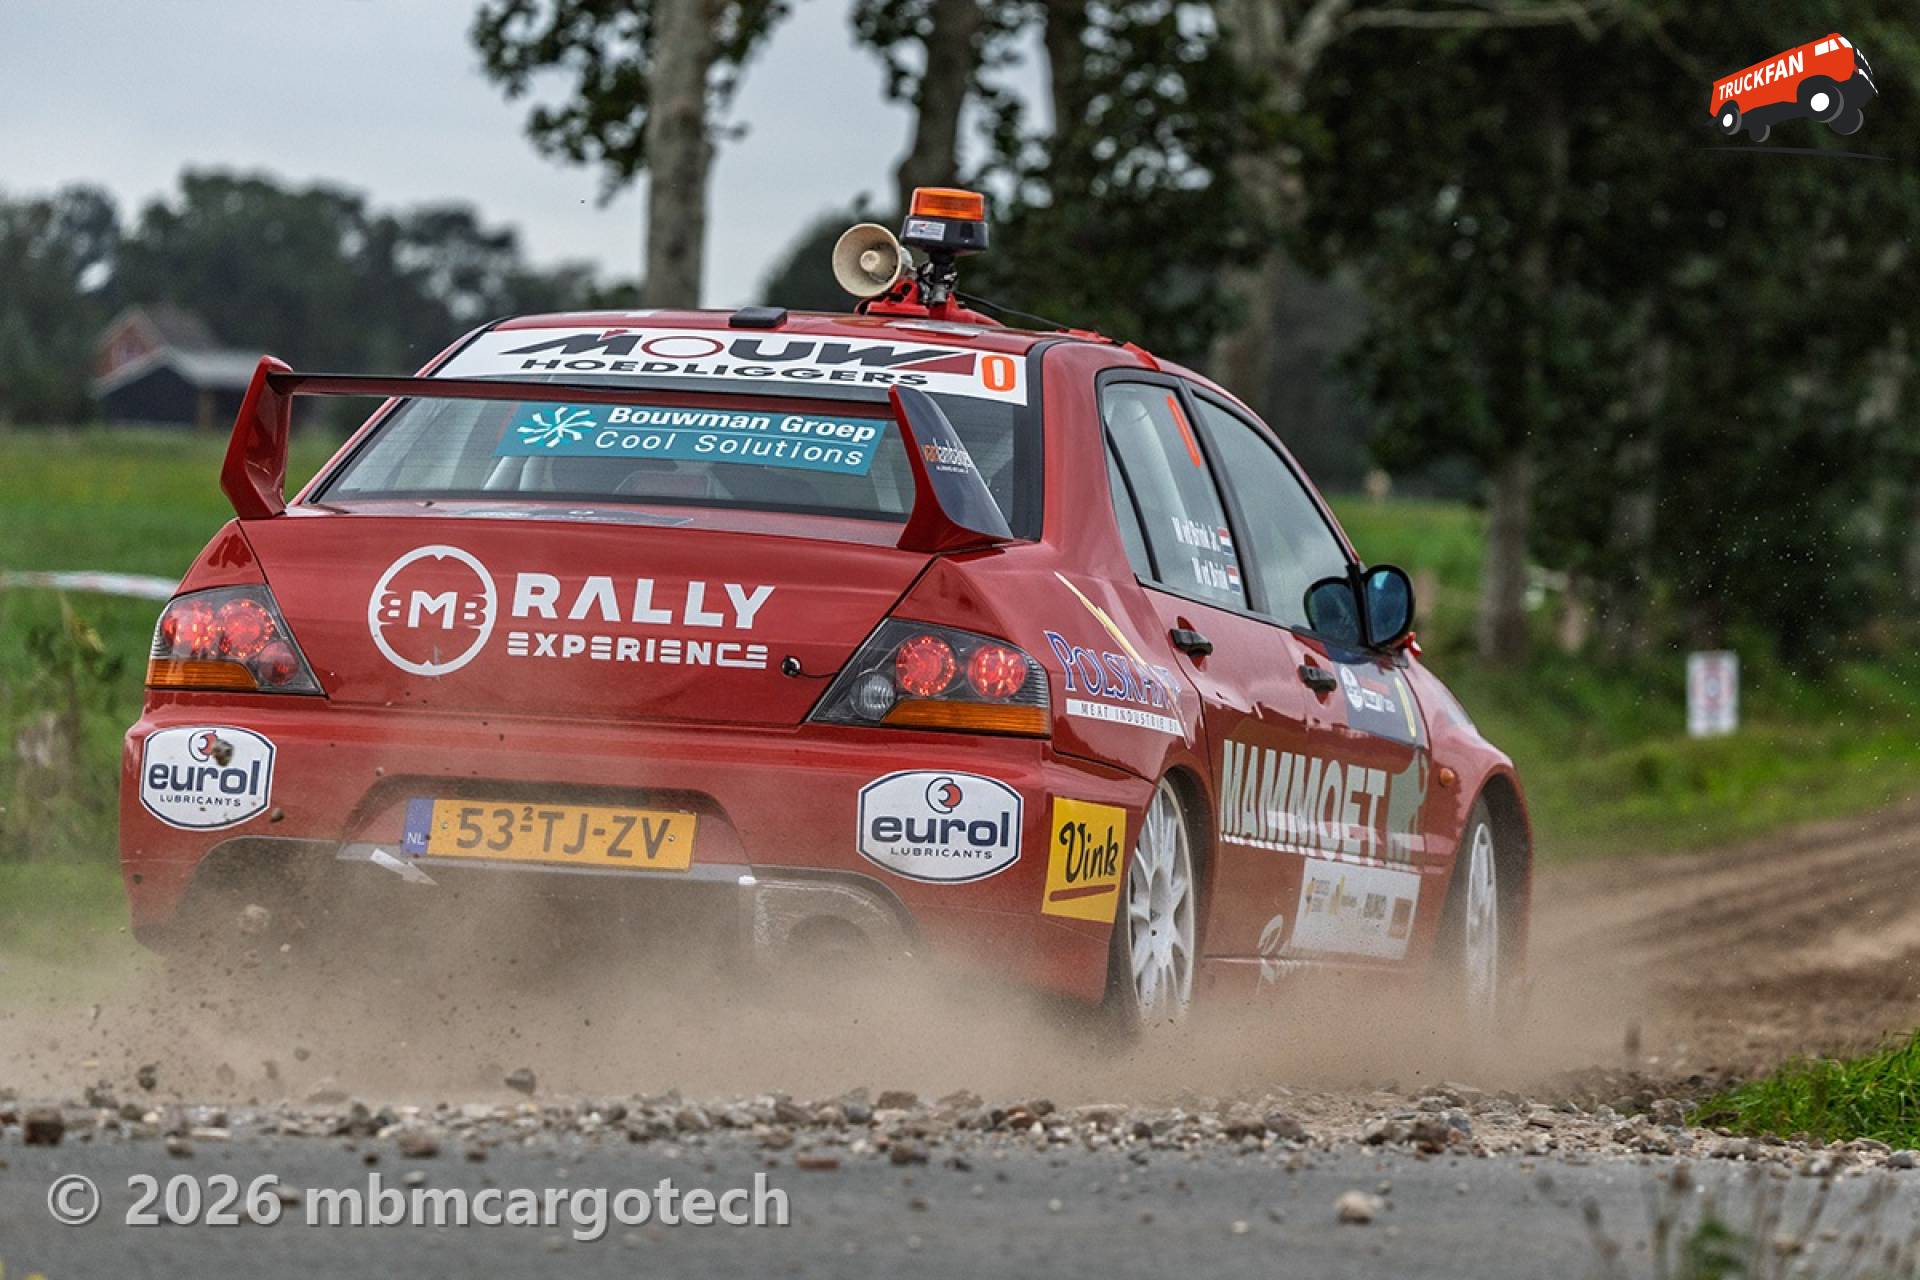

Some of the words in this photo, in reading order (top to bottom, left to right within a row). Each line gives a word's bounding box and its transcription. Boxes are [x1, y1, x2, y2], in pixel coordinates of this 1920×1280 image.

[521, 358, 928, 385] HOEDLIGGERS
[981, 354, 1016, 392] 0
[607, 407, 770, 430] Bouwman
[780, 415, 876, 442] Groep
[595, 431, 676, 450] Cool
[694, 434, 864, 466] Solutions
[511, 572, 776, 630] RALLY
[507, 631, 769, 670] EXPERIENCE
[149, 759, 260, 796] eurol
[160, 794, 241, 807] LUBRICANTS
[1220, 738, 1387, 858] MAMMOET
[407, 832, 425, 846] NL
[871, 811, 1010, 847] eurol
[890, 847, 993, 860] LUBRICANTS
[1059, 821, 1119, 883] Vink
